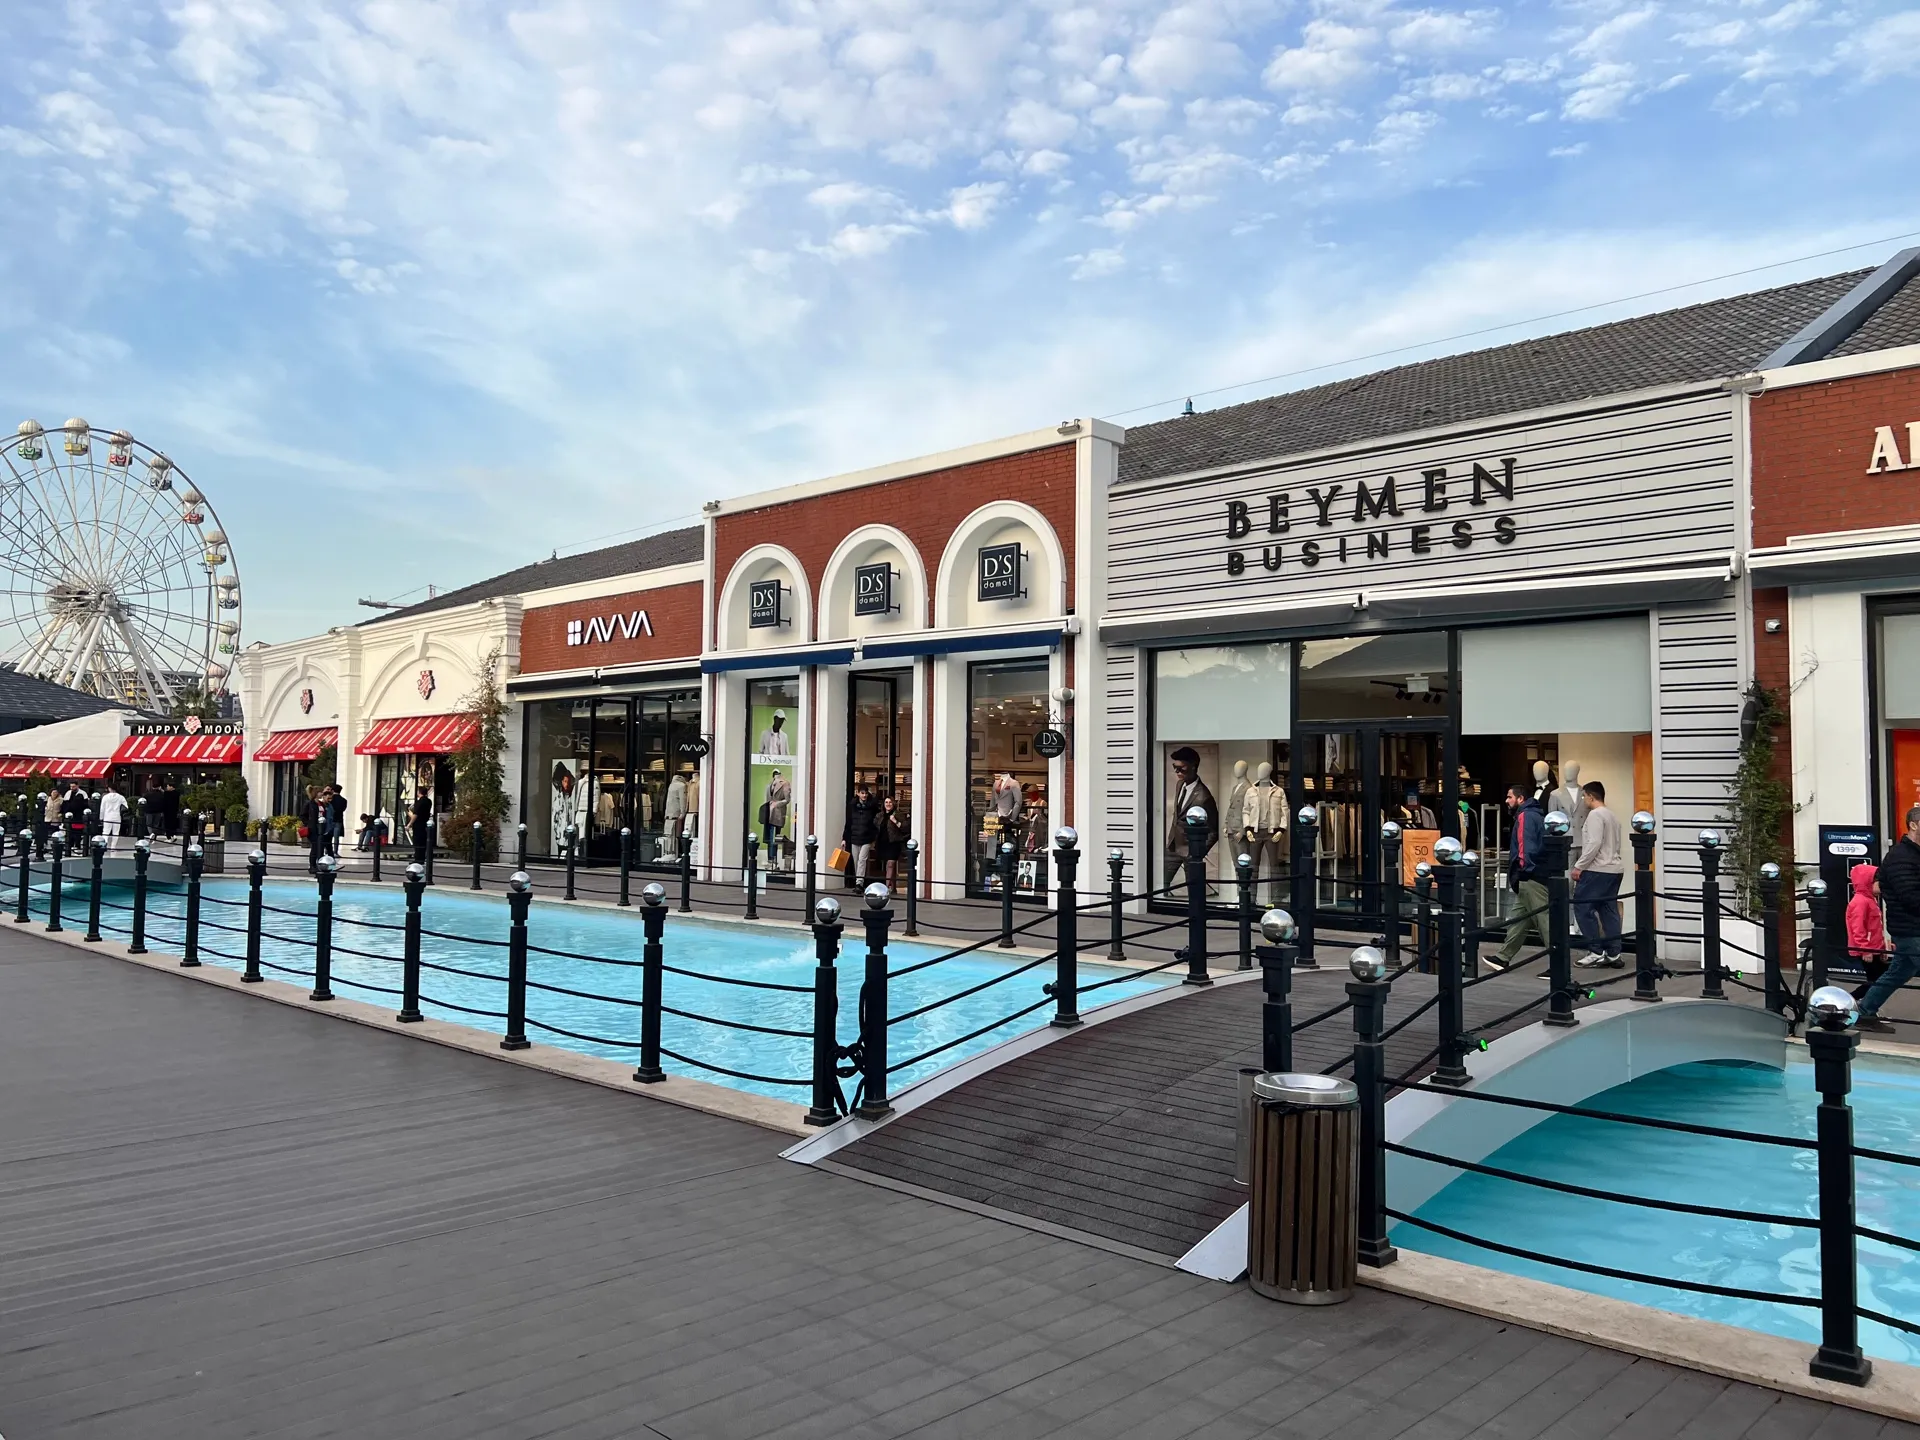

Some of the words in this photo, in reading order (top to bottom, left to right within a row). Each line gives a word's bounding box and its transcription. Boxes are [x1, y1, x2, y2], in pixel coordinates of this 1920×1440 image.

[1225, 457, 1517, 540] BEYMEN
[1227, 516, 1516, 576] BUSINESS
[983, 554, 1012, 577] D'S
[859, 573, 883, 594] D'S
[983, 577, 1012, 589] damat
[753, 589, 774, 608] D'S
[583, 610, 654, 645] AVVA
[137, 725, 180, 735] HAPPY
[204, 725, 241, 735] MOON
[679, 744, 707, 752] AVVA
[1414, 845, 1429, 856] 50
